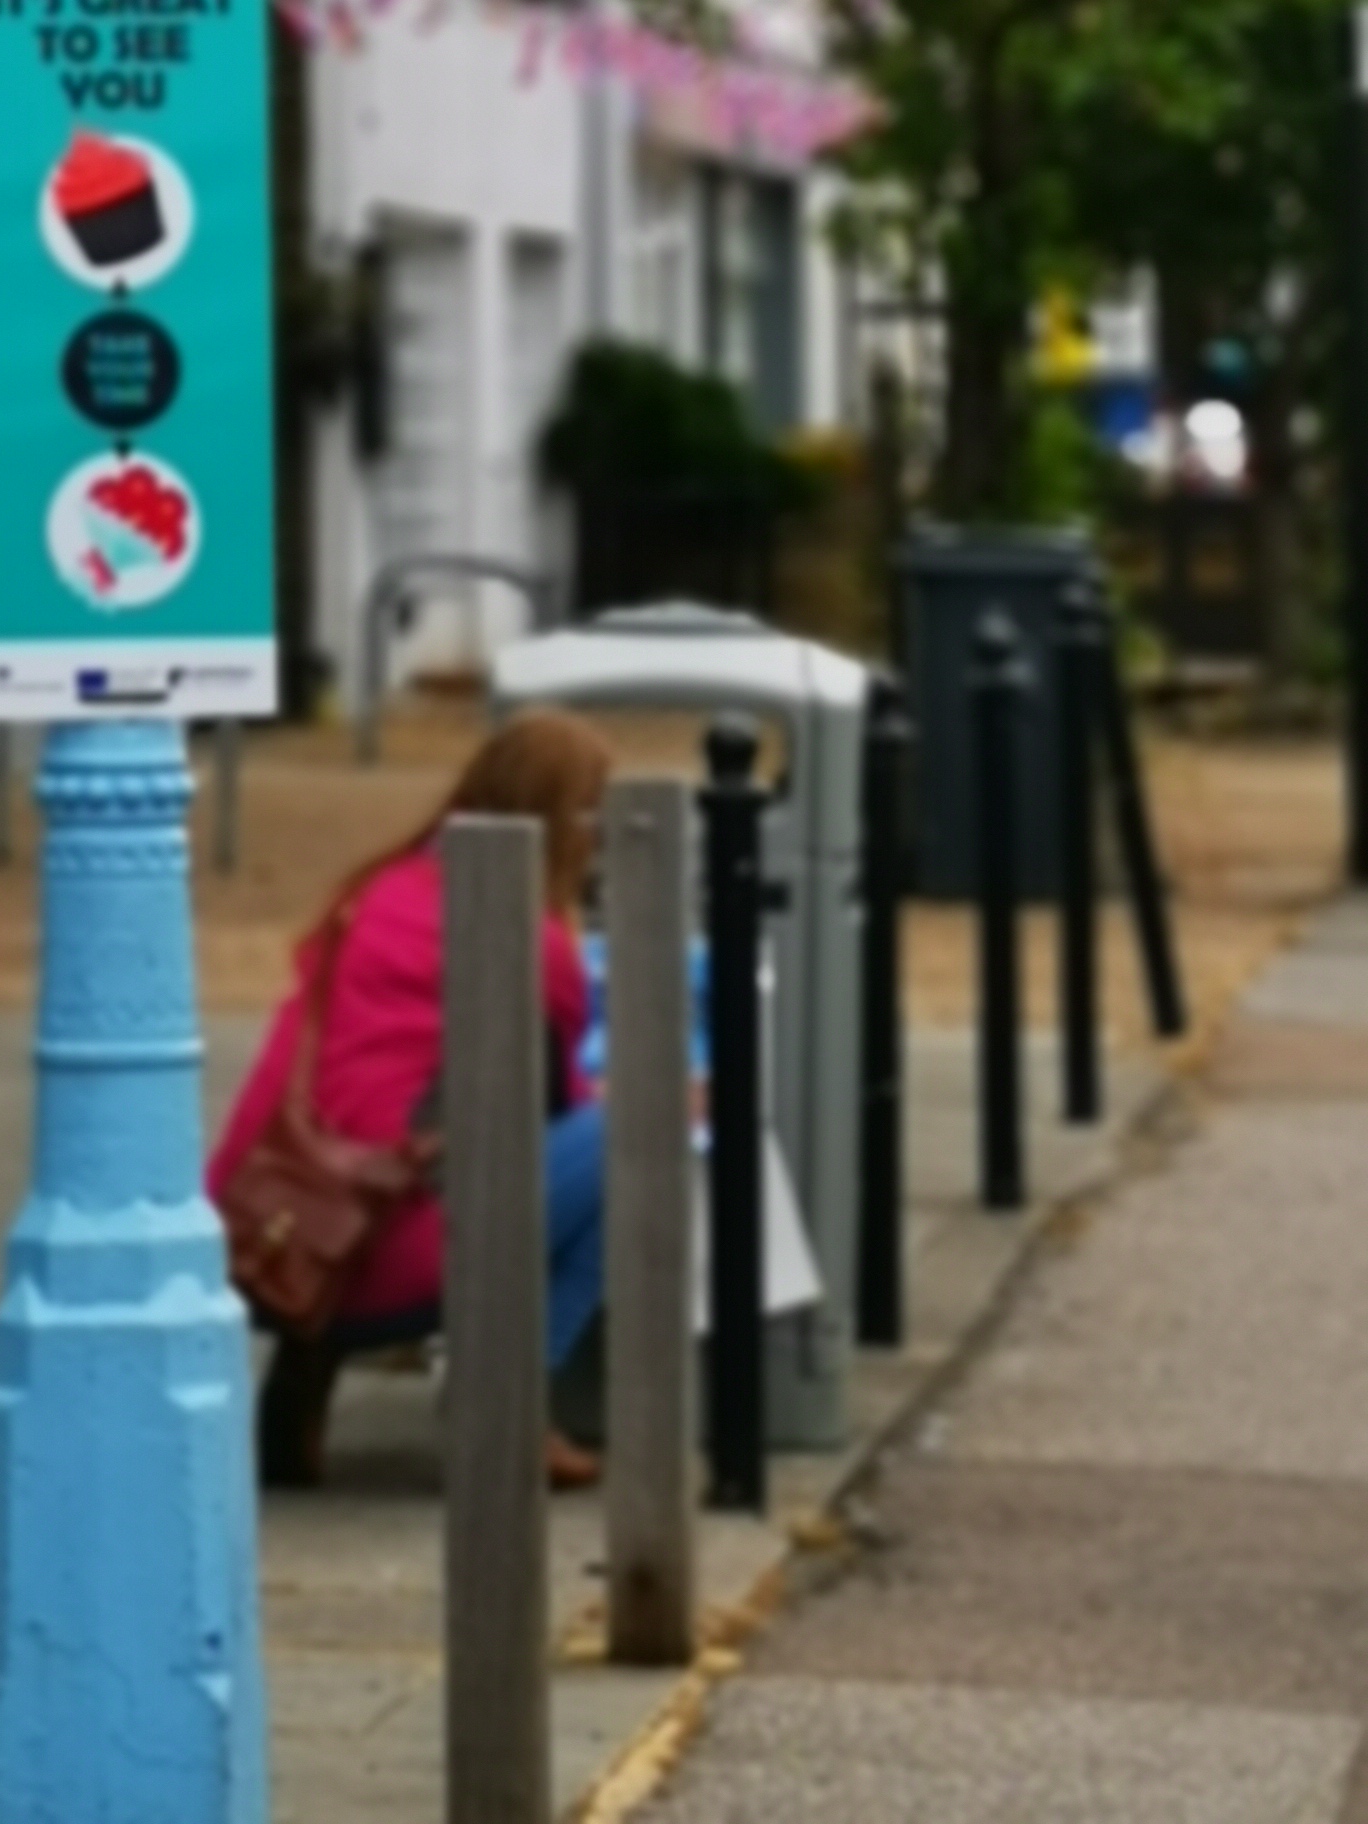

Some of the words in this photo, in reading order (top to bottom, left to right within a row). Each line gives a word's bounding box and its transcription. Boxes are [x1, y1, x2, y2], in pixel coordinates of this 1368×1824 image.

[35, 24, 99, 63] TO
[114, 24, 188, 63] SEE
[59, 71, 165, 111] YOU
